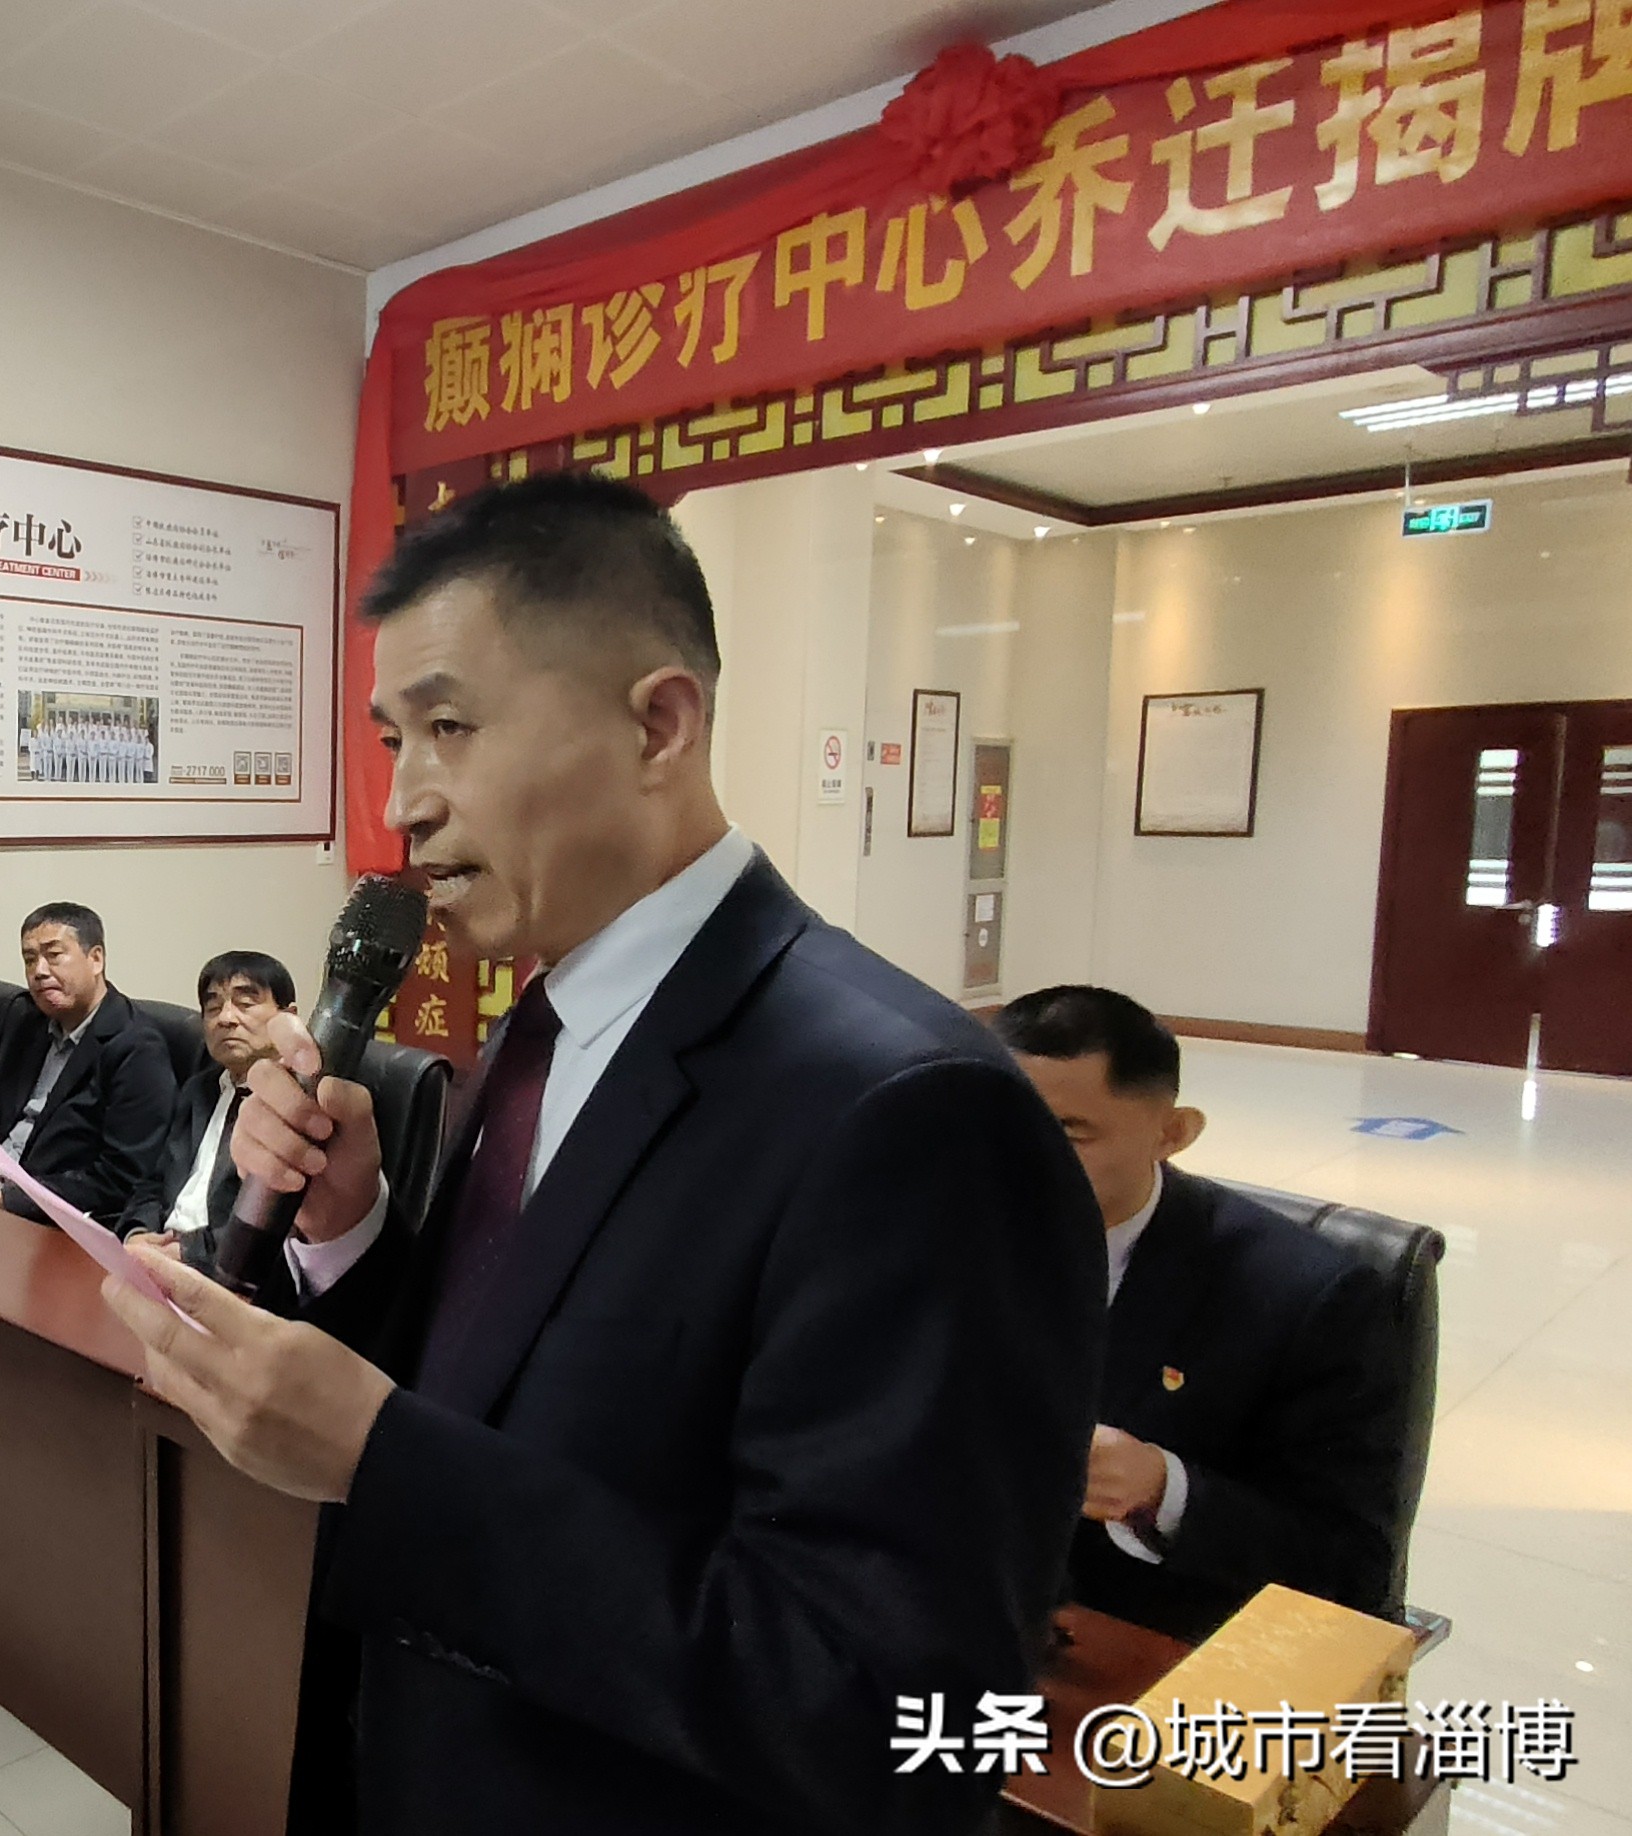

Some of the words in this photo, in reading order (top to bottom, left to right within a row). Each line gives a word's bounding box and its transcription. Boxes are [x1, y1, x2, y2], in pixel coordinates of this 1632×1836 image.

[424, 0, 1632, 432] 癫痫诊疗中心乔迁揭牌
[41, 566, 76, 580] CENTER
